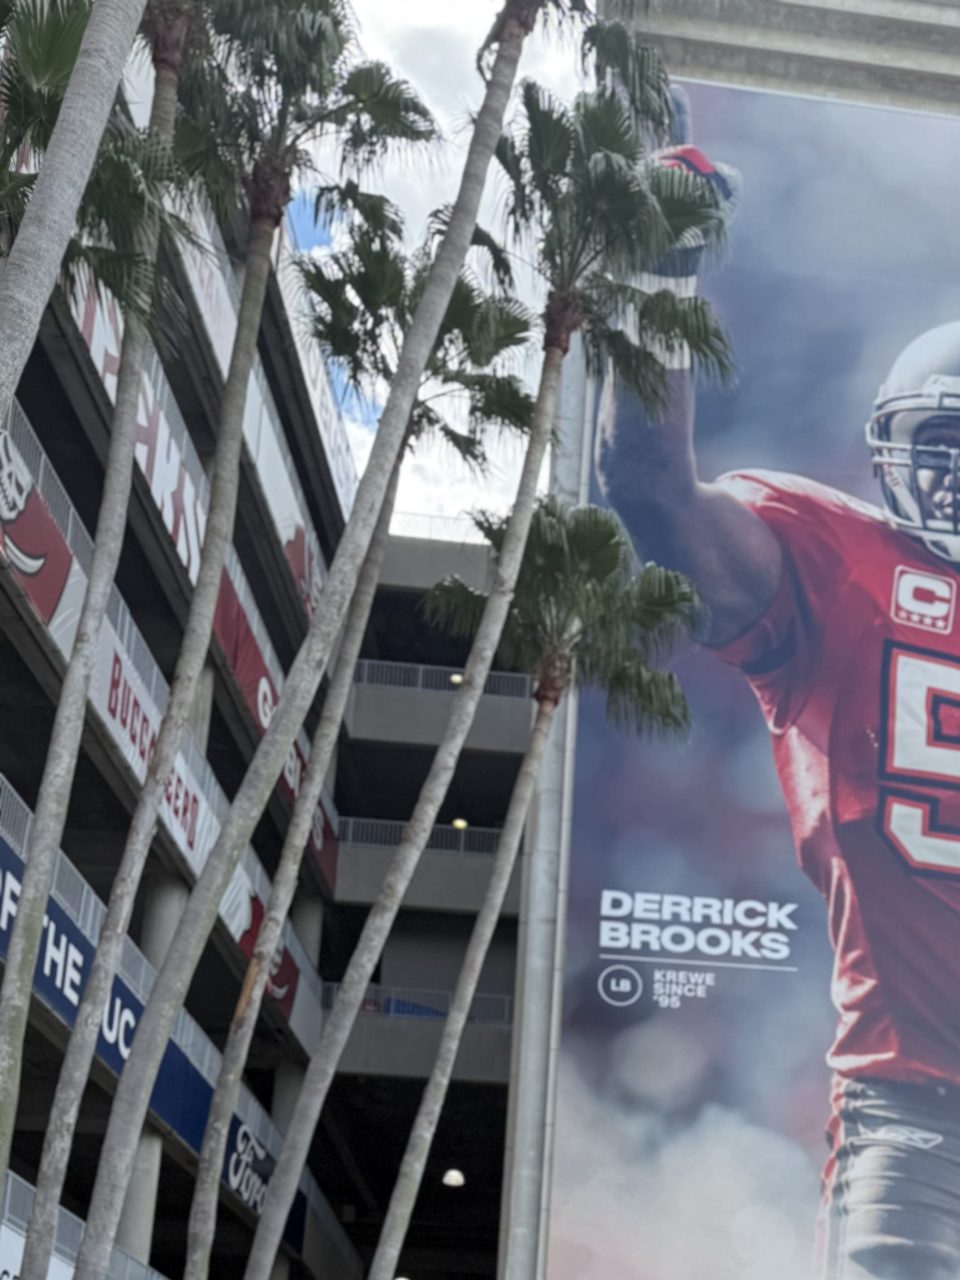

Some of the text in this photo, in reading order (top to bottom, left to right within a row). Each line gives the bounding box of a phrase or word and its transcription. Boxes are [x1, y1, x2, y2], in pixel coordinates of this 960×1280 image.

[600, 890, 798, 930] DERRICK
[599, 920, 791, 960] BROOKS
[42, 912, 84, 1007] HE
[610, 978, 632, 992] LB
[653, 983, 707, 998] SINCE
[654, 969, 716, 985] KREWE
